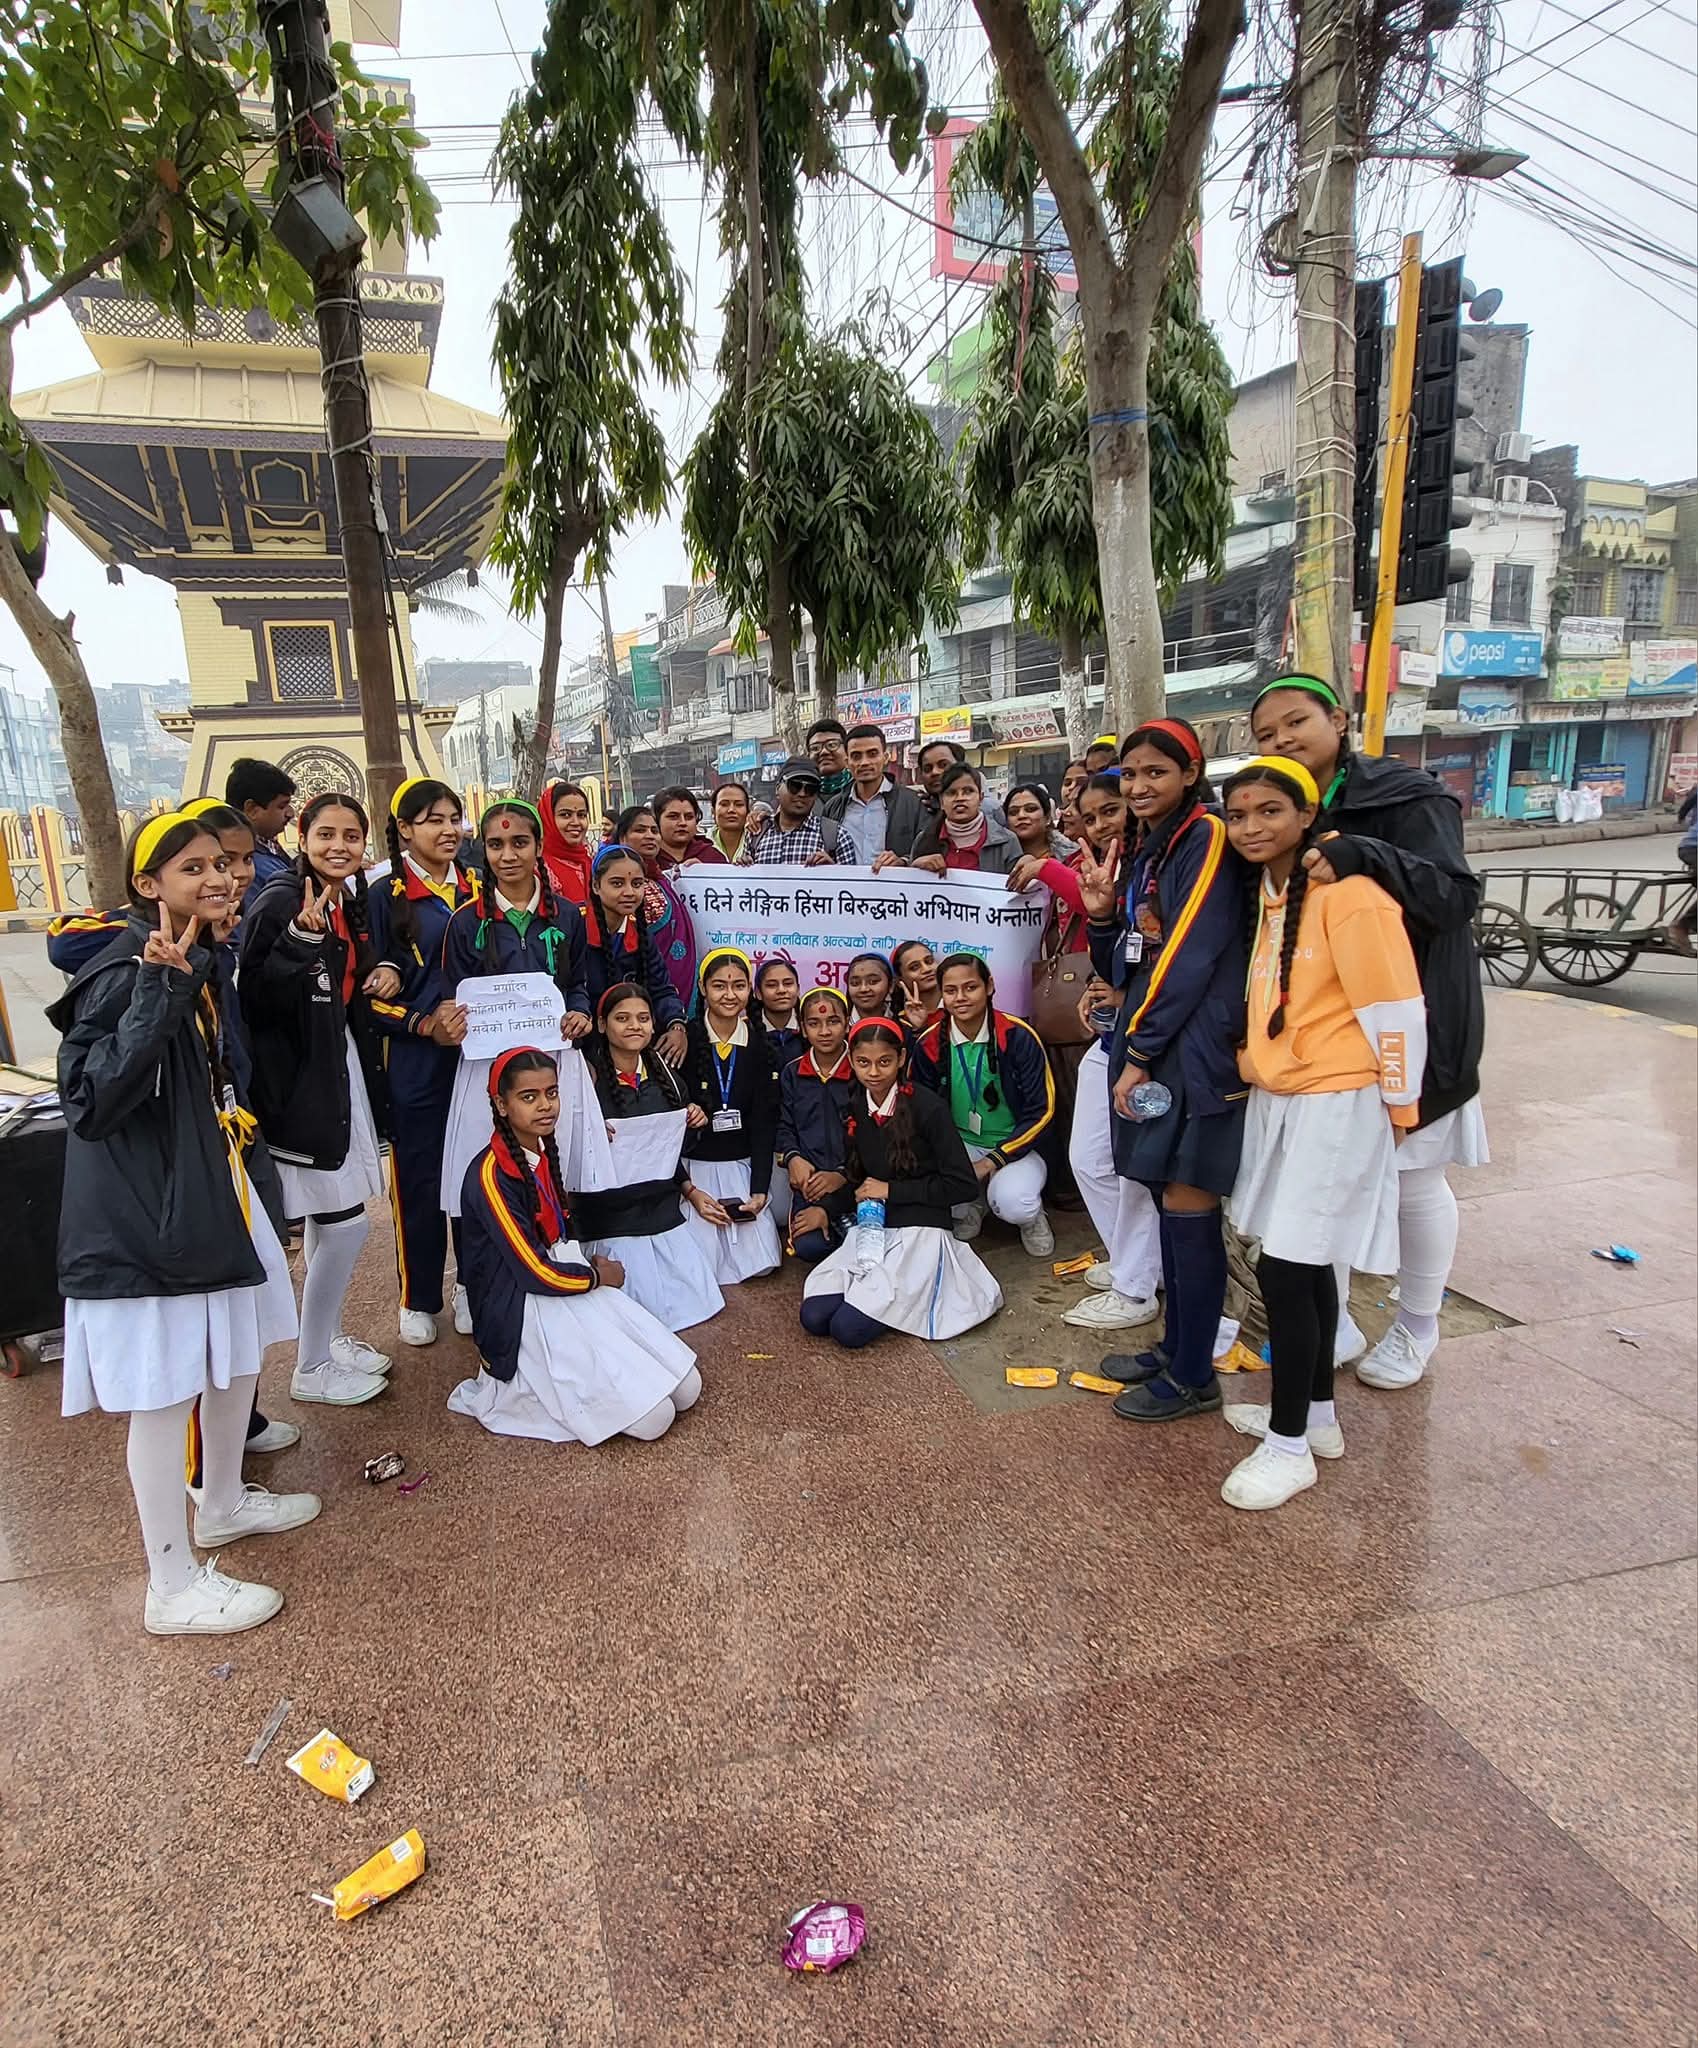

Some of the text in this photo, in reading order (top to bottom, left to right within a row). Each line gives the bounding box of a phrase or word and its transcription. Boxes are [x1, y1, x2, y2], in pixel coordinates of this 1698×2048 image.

[1469, 640, 1506, 665] pepsi
[704, 887, 733, 913] दिने
[739, 888, 789, 917] लैङ्गिक
[795, 889, 832, 917] हिंसा
[838, 891, 908, 920] बिरुद्धको
[914, 894, 980, 924] अभियान
[986, 901, 1042, 927] अन्तर्गत
[1380, 1037, 1403, 1090] LIKE
